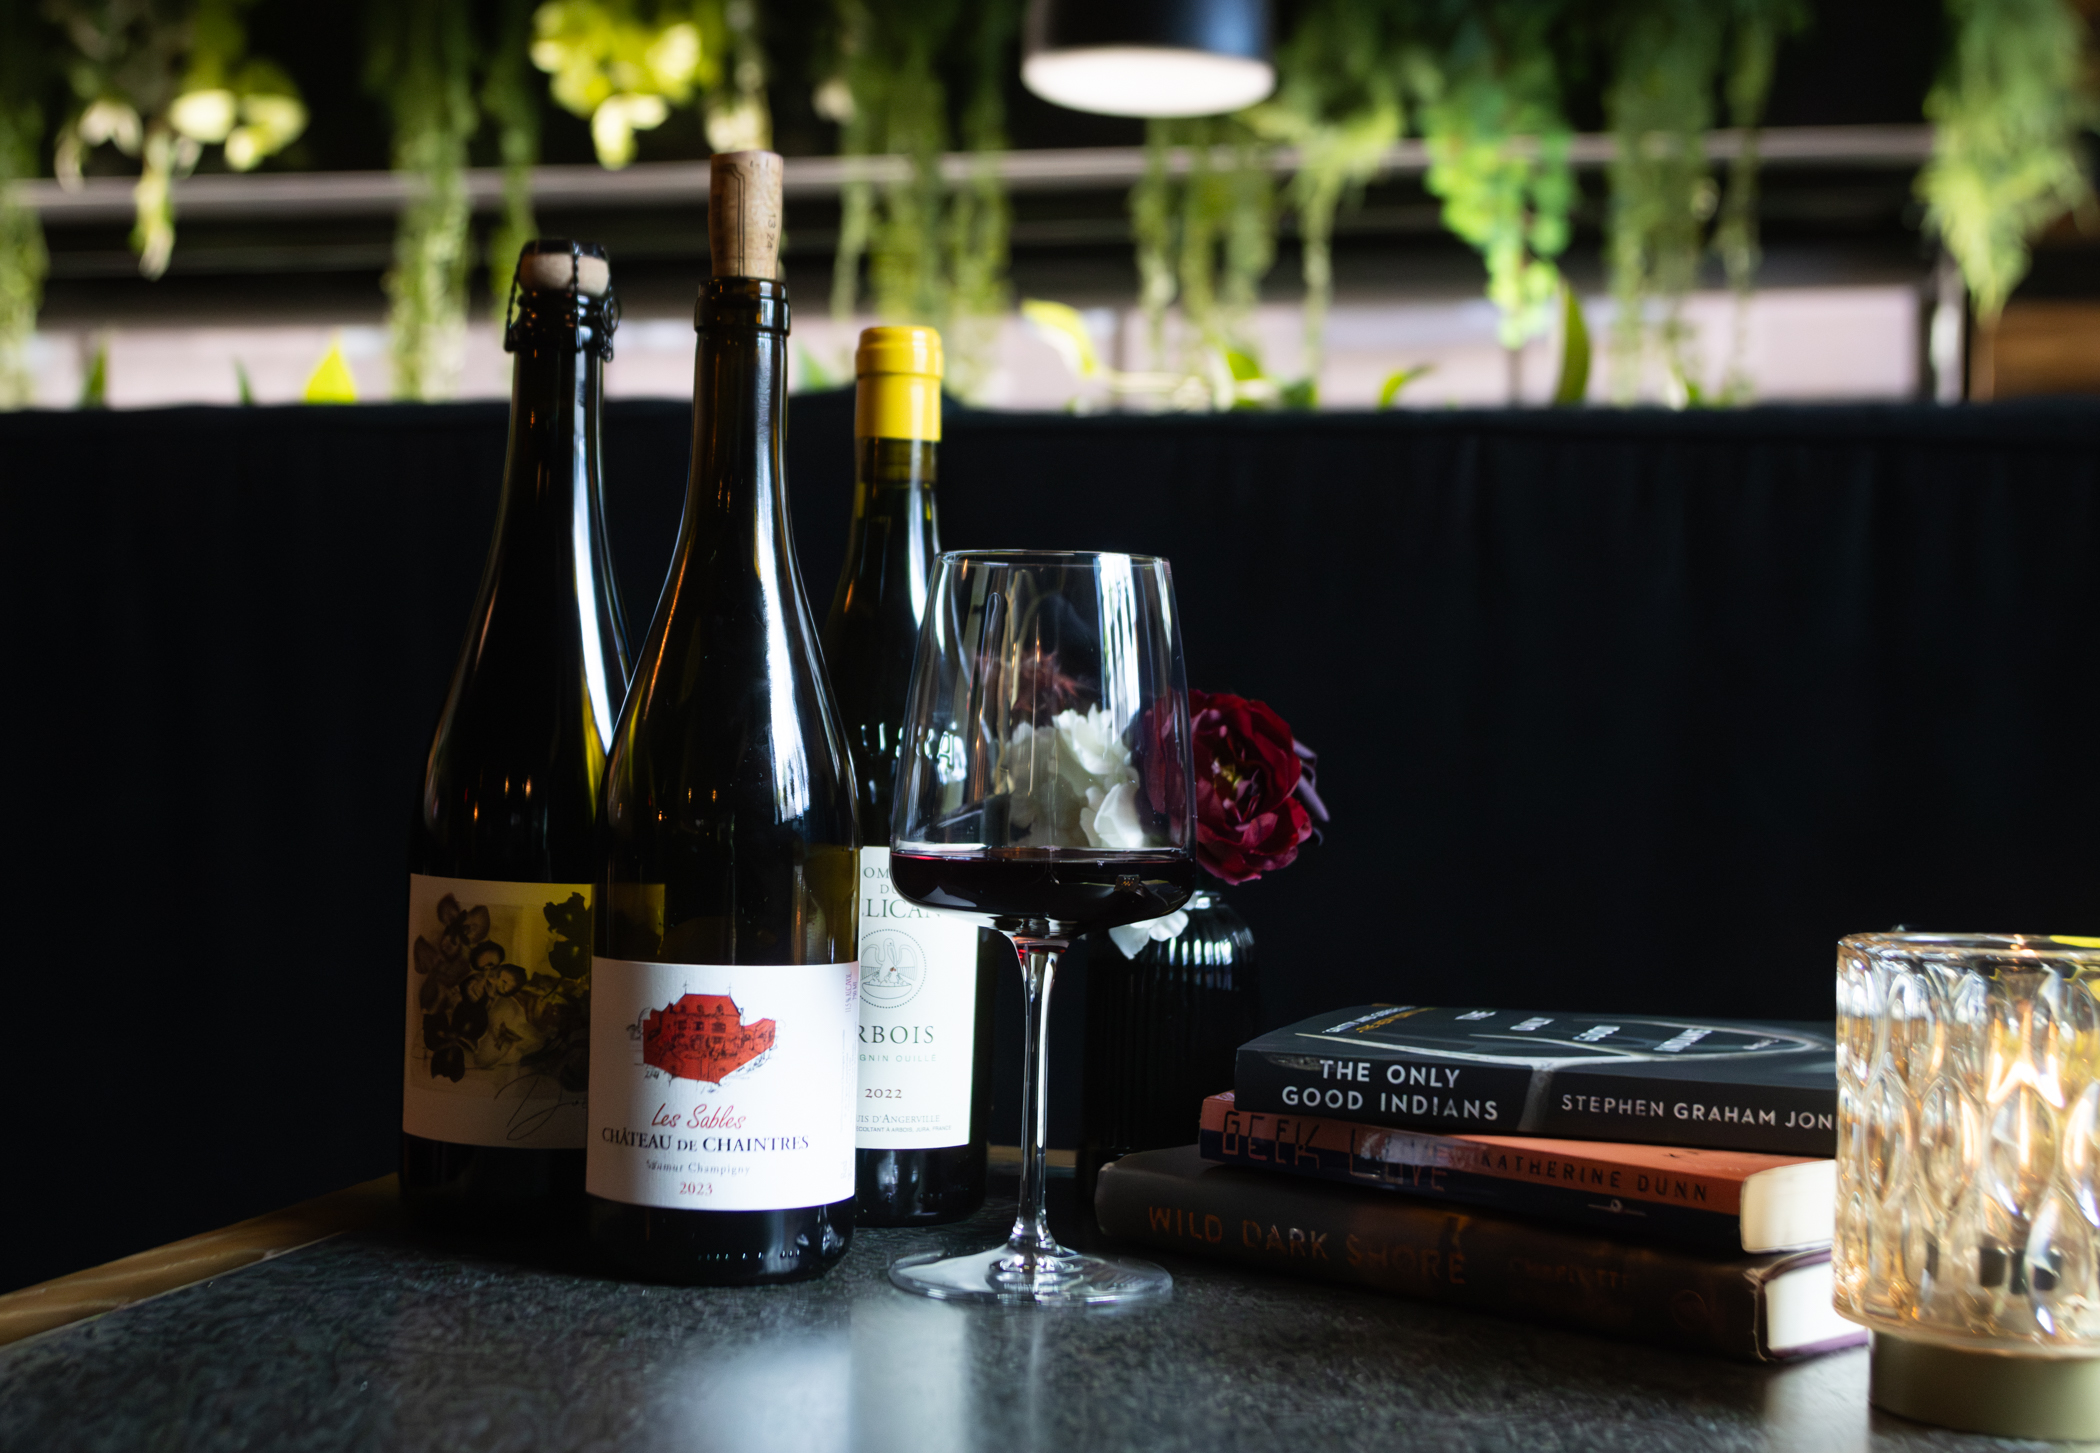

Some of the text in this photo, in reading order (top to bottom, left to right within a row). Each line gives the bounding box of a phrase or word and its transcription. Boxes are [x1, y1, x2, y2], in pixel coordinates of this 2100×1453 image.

[858, 1024, 934, 1045] RBOIS
[859, 1053, 889, 1062] GNIN
[1319, 1059, 1461, 1088] THE ONLY
[864, 1088, 903, 1099] 2022
[1281, 1085, 1499, 1121] GOOD INDIANS
[651, 1102, 747, 1130] Les Sables
[1561, 1094, 1834, 1131] STEPHEN GRAHAM JON
[601, 1126, 674, 1151] CHÂTEAU
[702, 1135, 810, 1152] CHAINTRES
[1222, 1110, 1320, 1171] GEEK
[687, 1161, 751, 1176] Champigny
[1480, 1149, 1708, 1201] KATHERINE DUNN
[679, 1181, 713, 1196] 2023
[1148, 1206, 1223, 1244] WILD
[1242, 1219, 1330, 1261] DARK
[1345, 1232, 1467, 1285] SHORE
